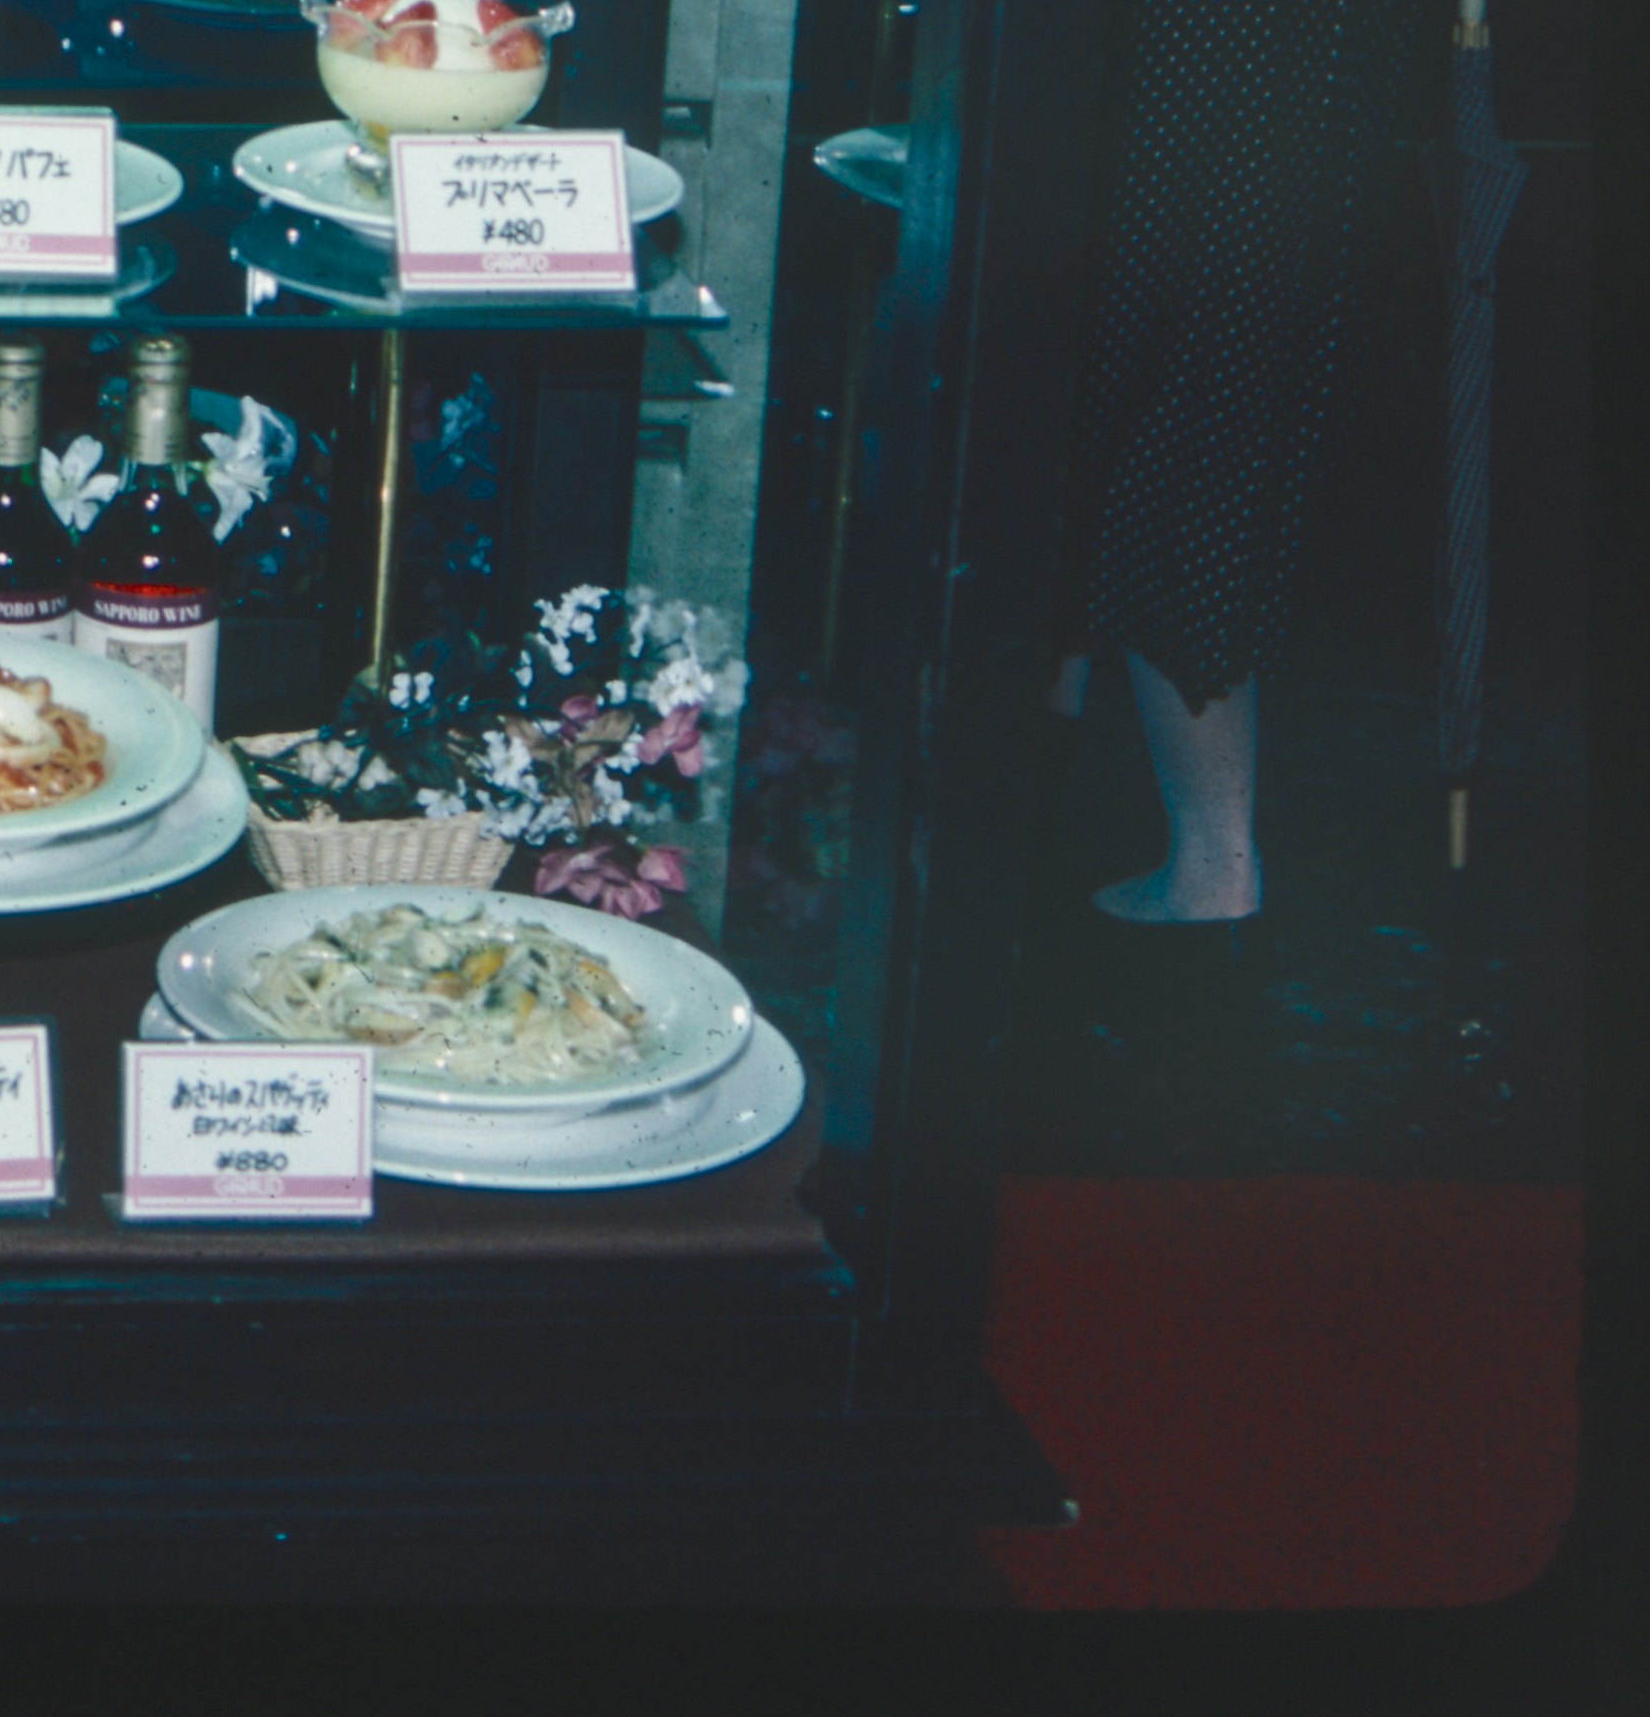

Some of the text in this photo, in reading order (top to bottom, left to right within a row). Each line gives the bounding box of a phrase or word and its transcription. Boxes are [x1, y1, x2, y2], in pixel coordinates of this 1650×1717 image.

[441, 178, 579, 210] プリマベーラ
[482, 218, 545, 246] ¥480
[94, 599, 161, 624] SAPPORO
[215, 1150, 289, 1173] ¥880
